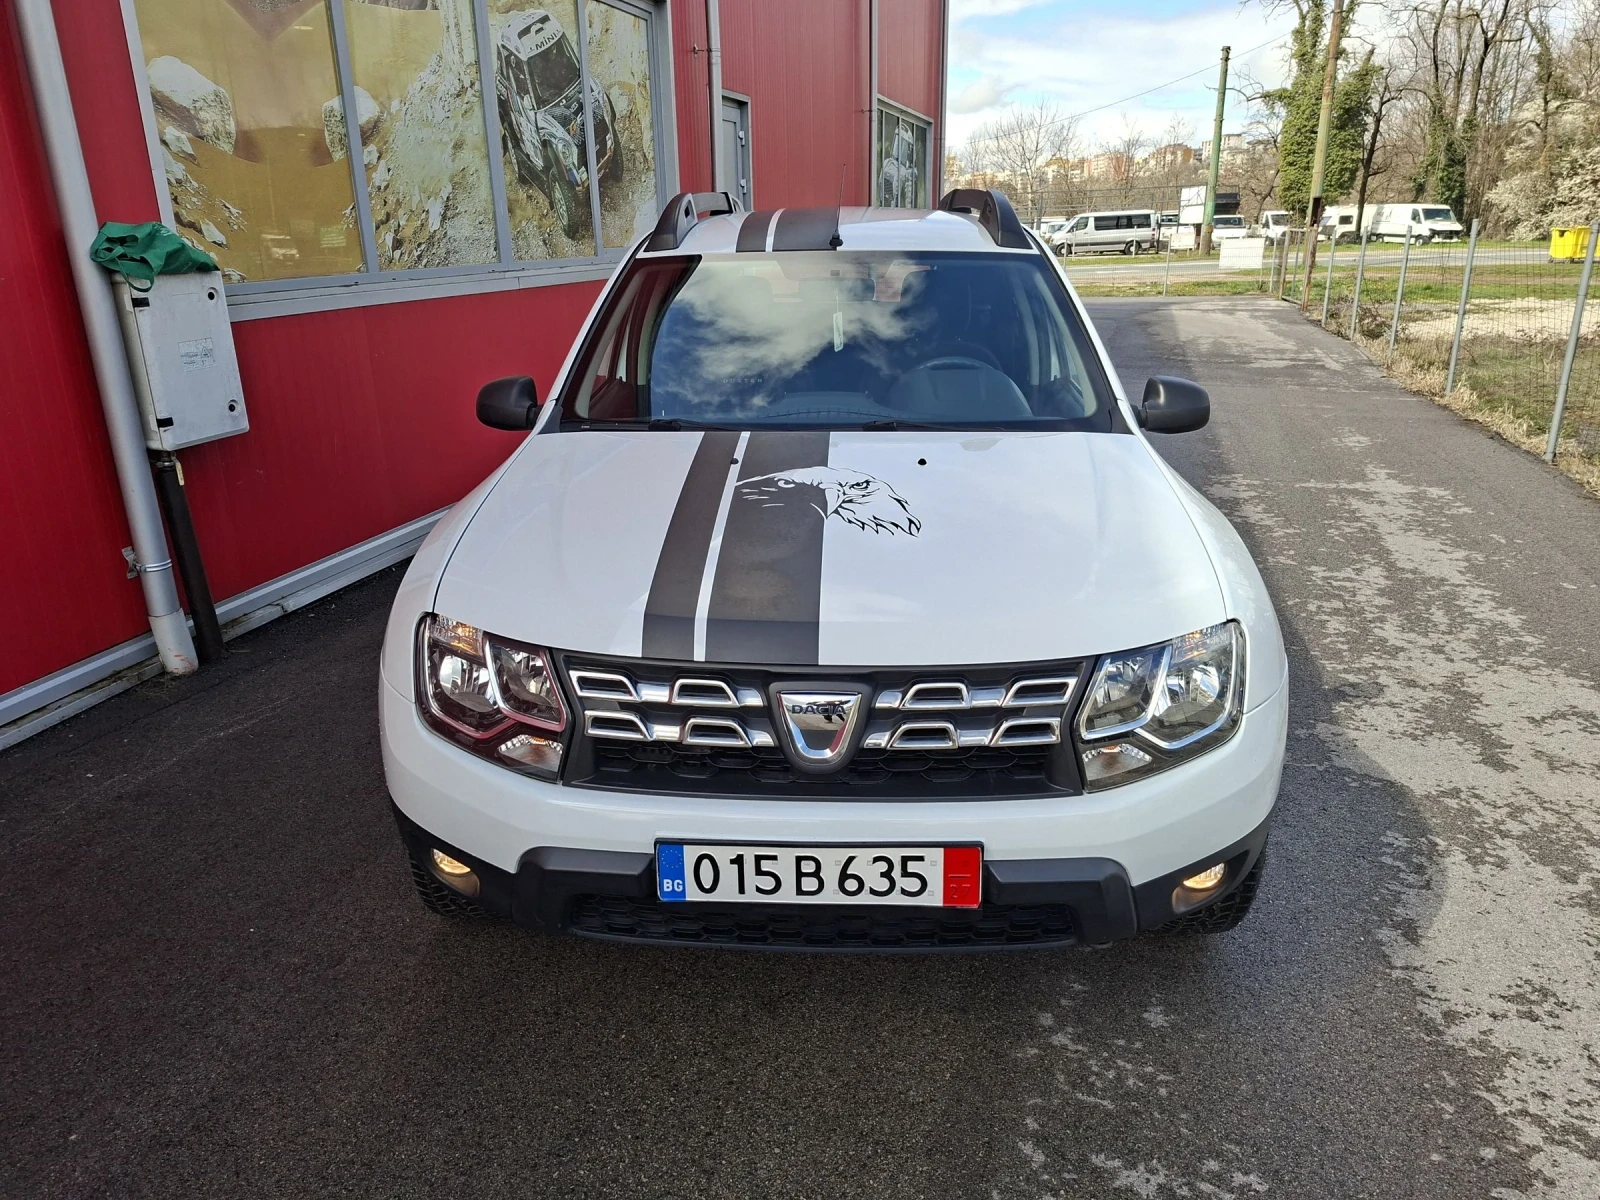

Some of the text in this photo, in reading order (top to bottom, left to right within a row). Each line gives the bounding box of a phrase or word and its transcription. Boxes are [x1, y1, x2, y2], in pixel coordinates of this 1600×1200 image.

[791, 704, 847, 715] DACIA
[693, 853, 782, 895] 015
[837, 855, 928, 898] 635
[663, 879, 684, 893] BG
